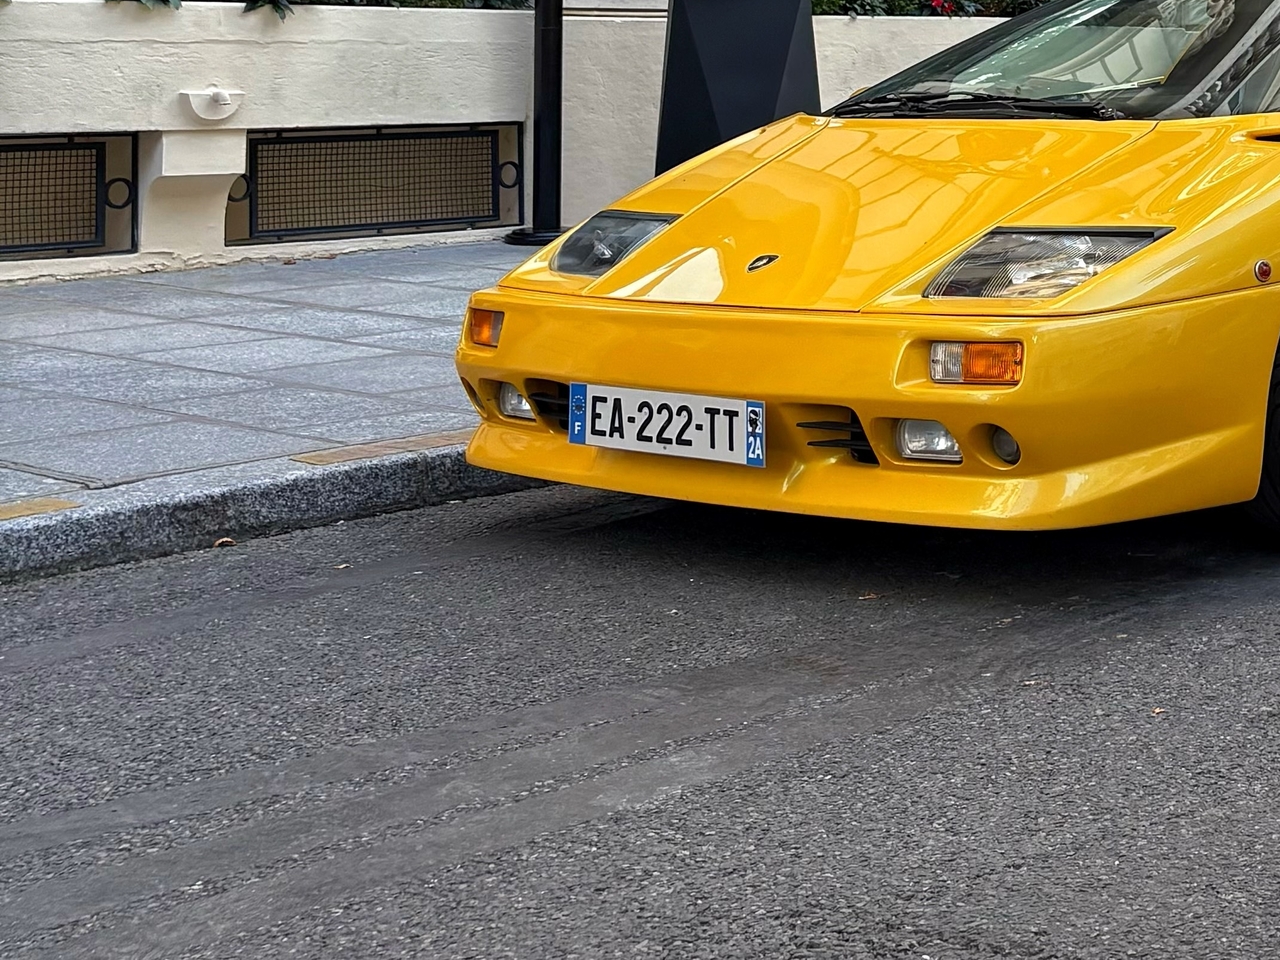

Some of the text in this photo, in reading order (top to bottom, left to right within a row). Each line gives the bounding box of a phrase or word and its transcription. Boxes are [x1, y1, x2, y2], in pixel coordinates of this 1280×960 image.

[574, 421, 582, 435] F
[590, 395, 740, 452] EA-222-TT
[748, 436, 763, 460] 2A
